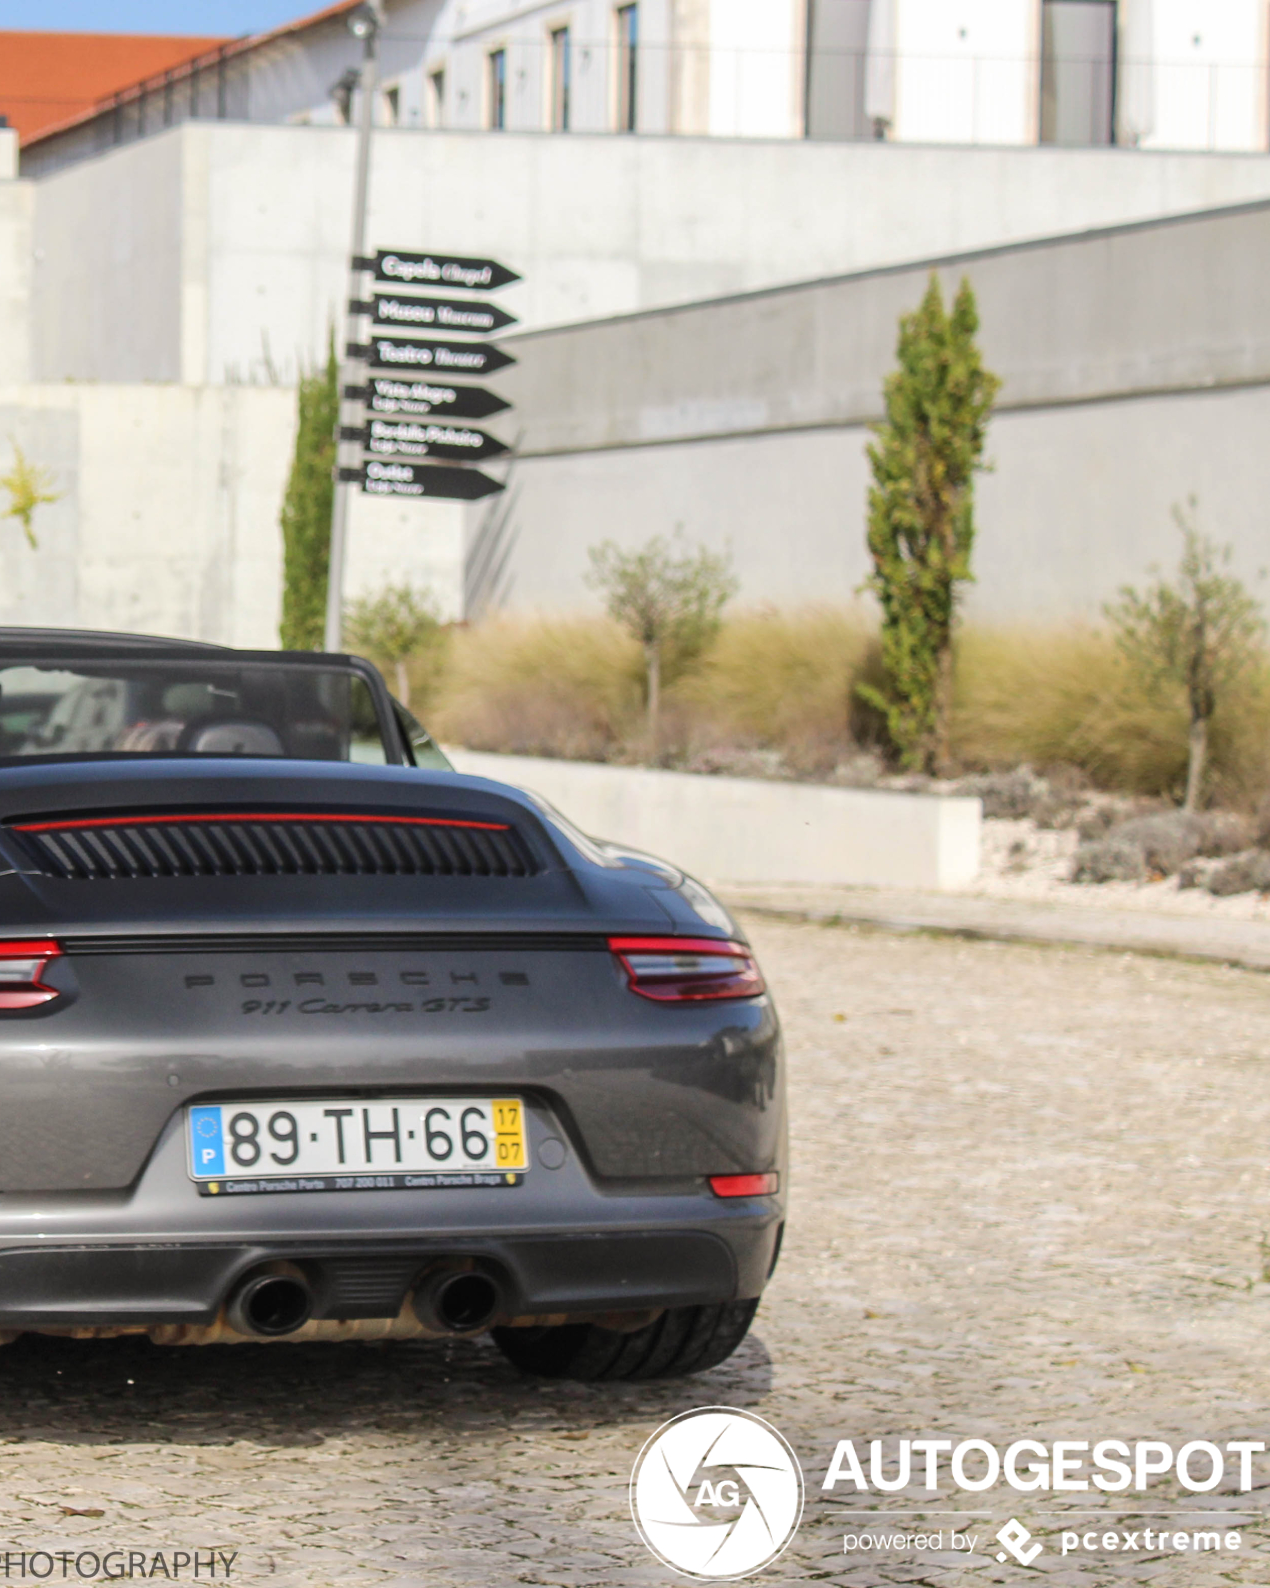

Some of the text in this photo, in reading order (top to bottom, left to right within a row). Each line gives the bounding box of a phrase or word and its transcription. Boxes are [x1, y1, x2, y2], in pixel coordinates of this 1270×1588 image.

[381, 255, 441, 281] Capela
[378, 299, 435, 323] Museu
[377, 341, 433, 364] Teatro
[184, 972, 531, 989] PORSCHE
[240, 998, 491, 1015] 911 Carrera GTS
[498, 1108, 518, 1126] 17
[202, 1148, 216, 1164] P
[498, 1142, 520, 1160] 07
[226, 1181, 258, 1193] Centro
[259, 1180, 298, 1191] Porsche
[299, 1178, 325, 1190] Porto
[404, 1175, 435, 1187] Centro
[436, 1174, 473, 1186] Porsche
